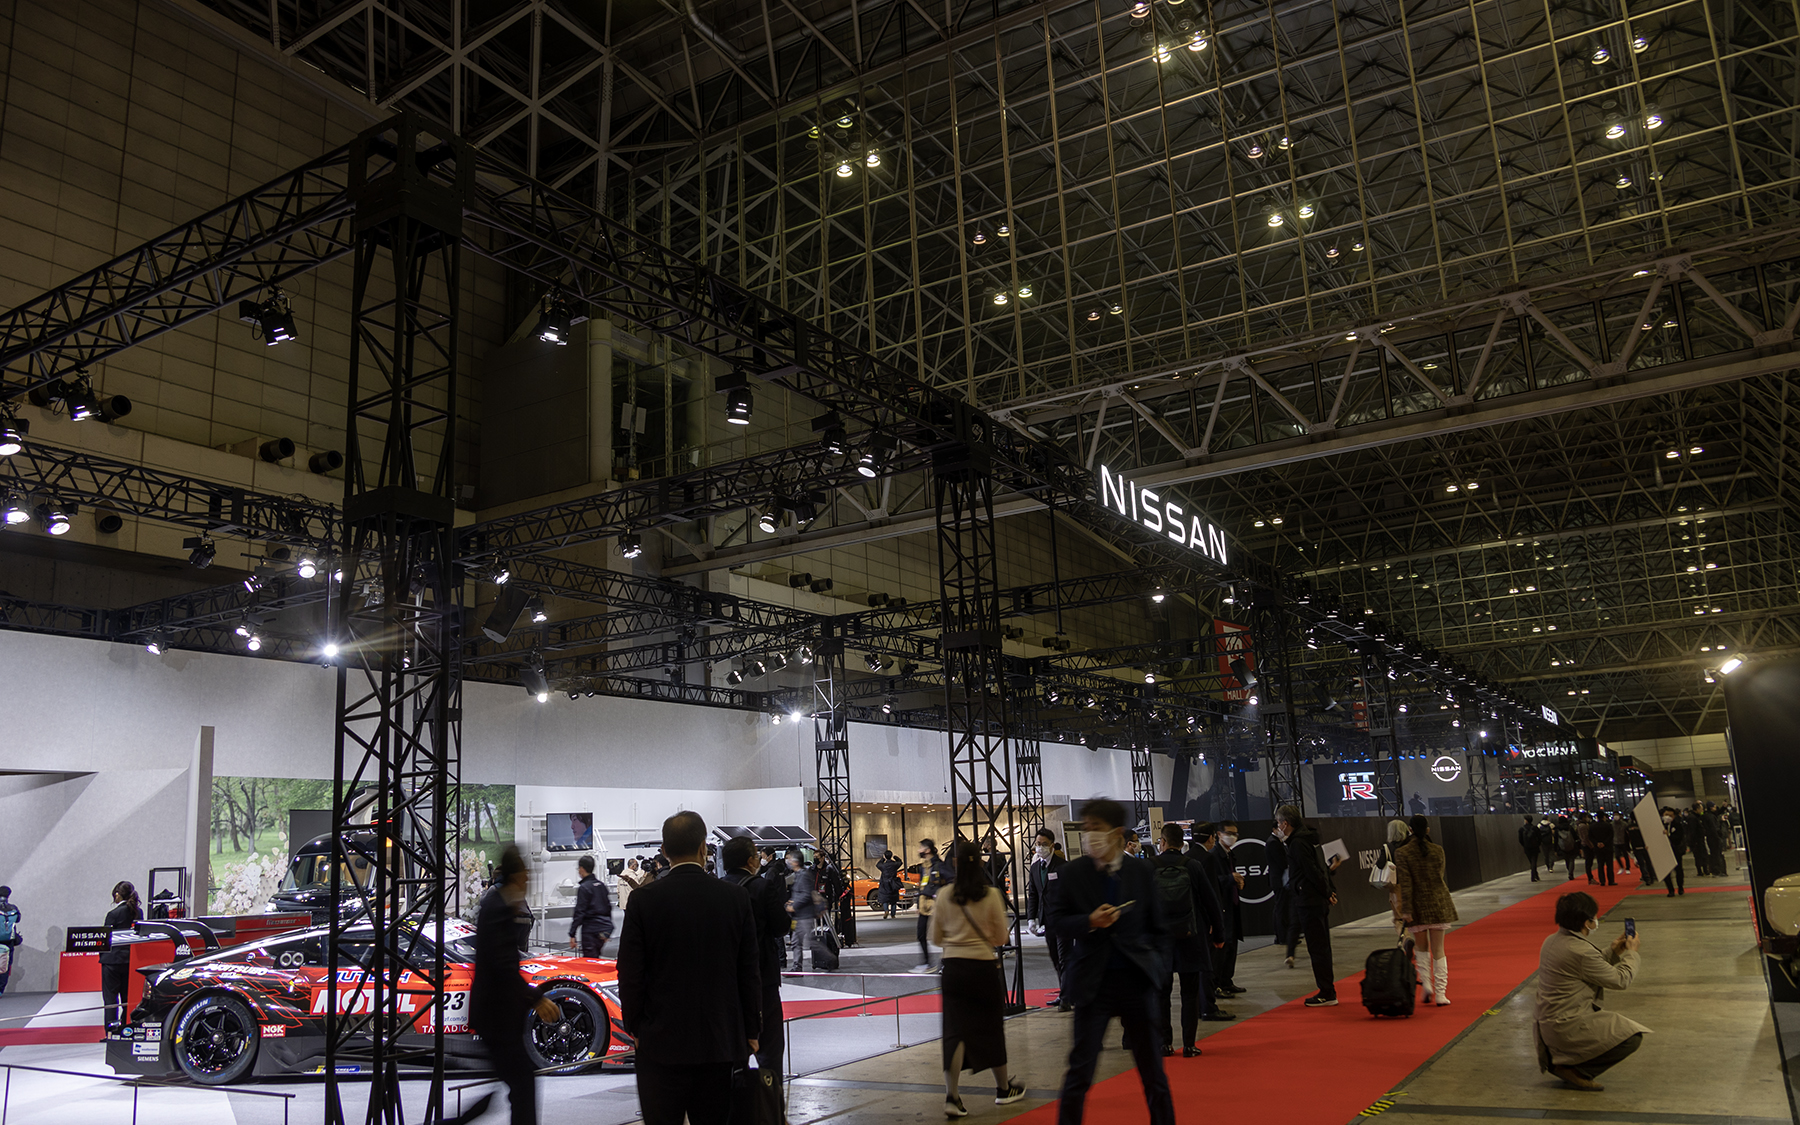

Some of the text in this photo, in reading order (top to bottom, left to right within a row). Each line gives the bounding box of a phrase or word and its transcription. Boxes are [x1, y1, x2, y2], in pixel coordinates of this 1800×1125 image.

[1101, 464, 1228, 566] NISSAN
[1430, 765, 1462, 773] NISSAN
[71, 932, 107, 940] NISSAN
[180, 999, 209, 1029] MICHELIN
[263, 1025, 285, 1034] NGK
[422, 1024, 469, 1034] TAADIC
